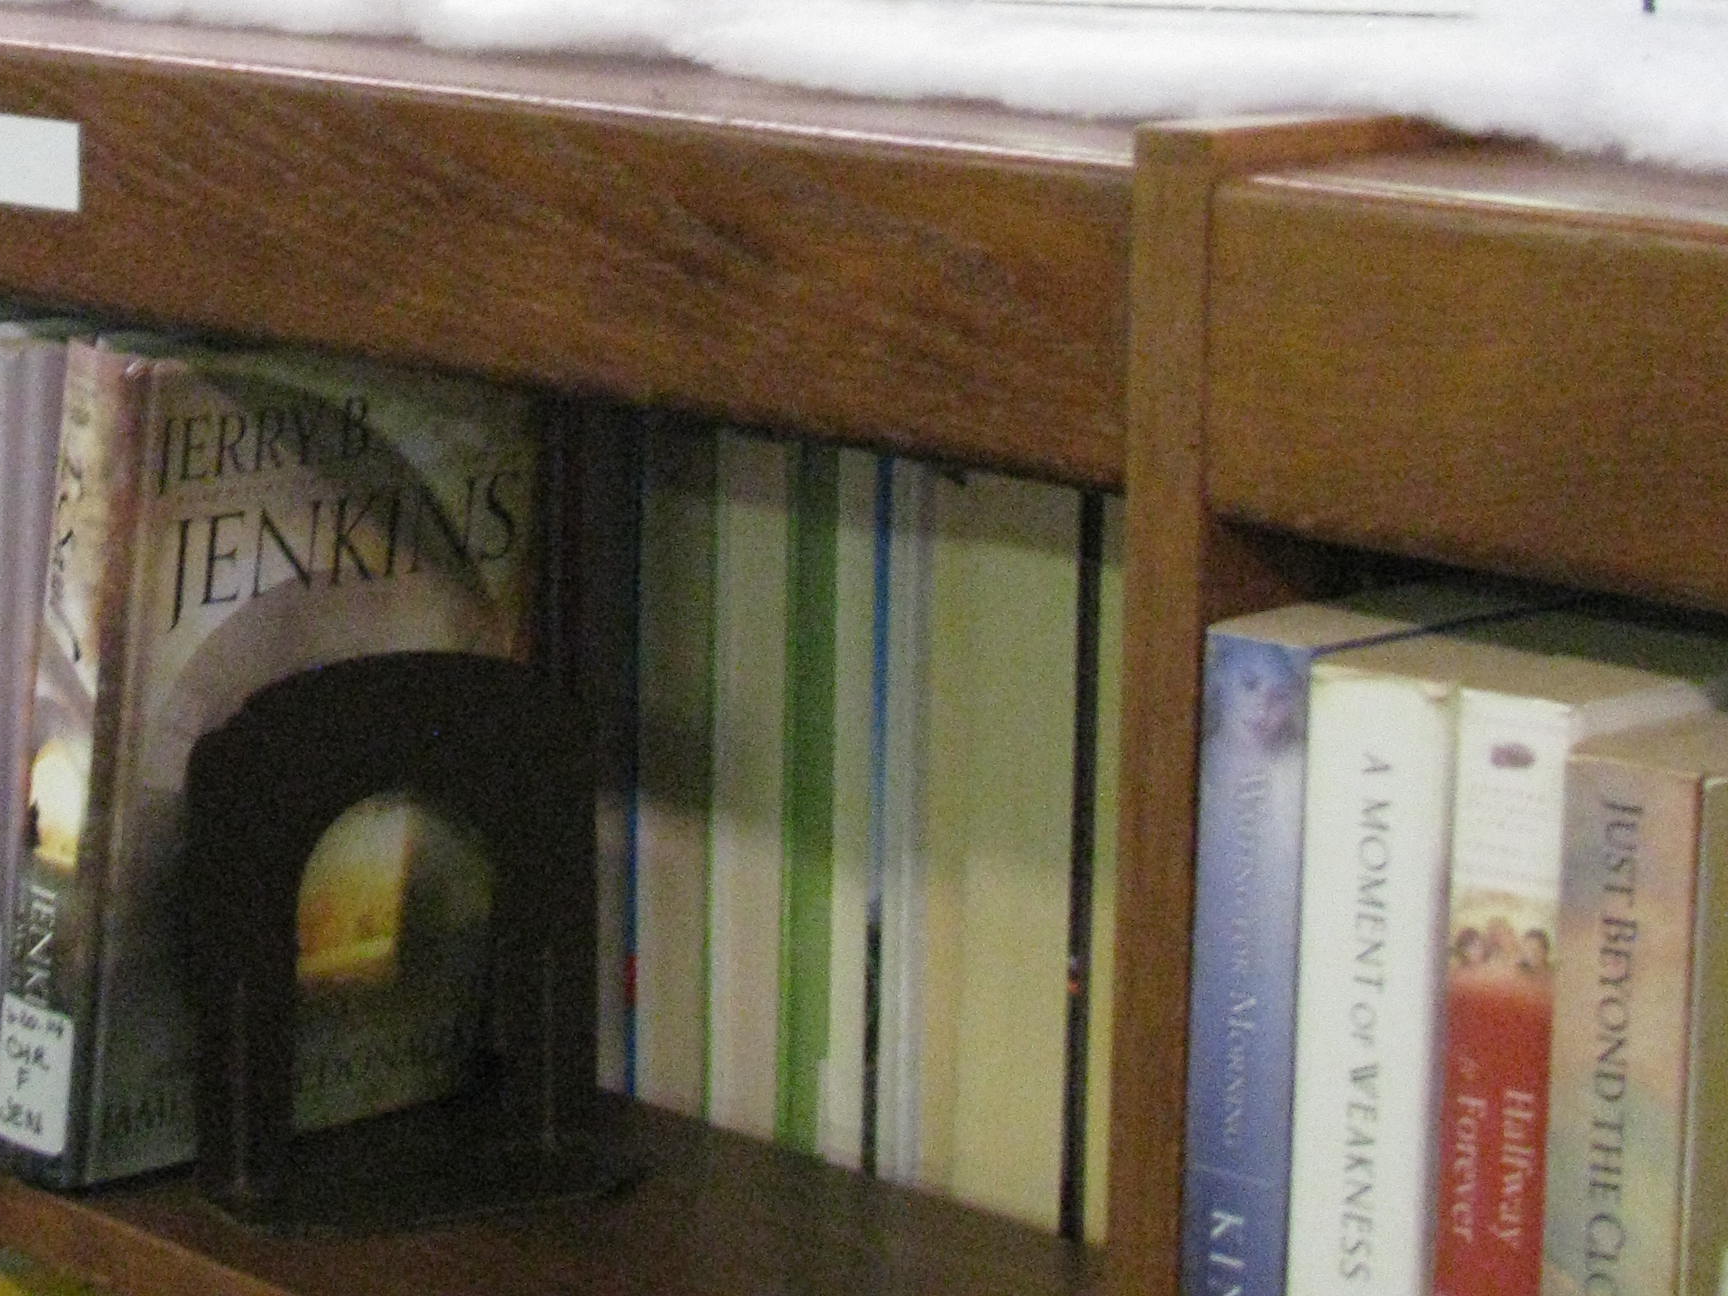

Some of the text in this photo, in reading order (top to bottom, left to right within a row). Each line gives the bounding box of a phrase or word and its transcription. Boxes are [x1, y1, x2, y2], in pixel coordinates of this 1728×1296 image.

[157, 407, 316, 495] JERRY
[170, 468, 518, 631] JENKINS
[1361, 750, 1392, 776] A
[1354, 798, 1393, 994] MOMENT
[1602, 795, 1644, 907] JUST
[1222, 990, 1258, 1148] MORNING
[1594, 916, 1639, 1105] BEYOND
[1339, 1063, 1380, 1282] WEAKNESS
[1450, 1094, 1485, 1244] Forever
[1490, 1088, 1537, 1253] Halfway
[1586, 1111, 1626, 1202] THE
